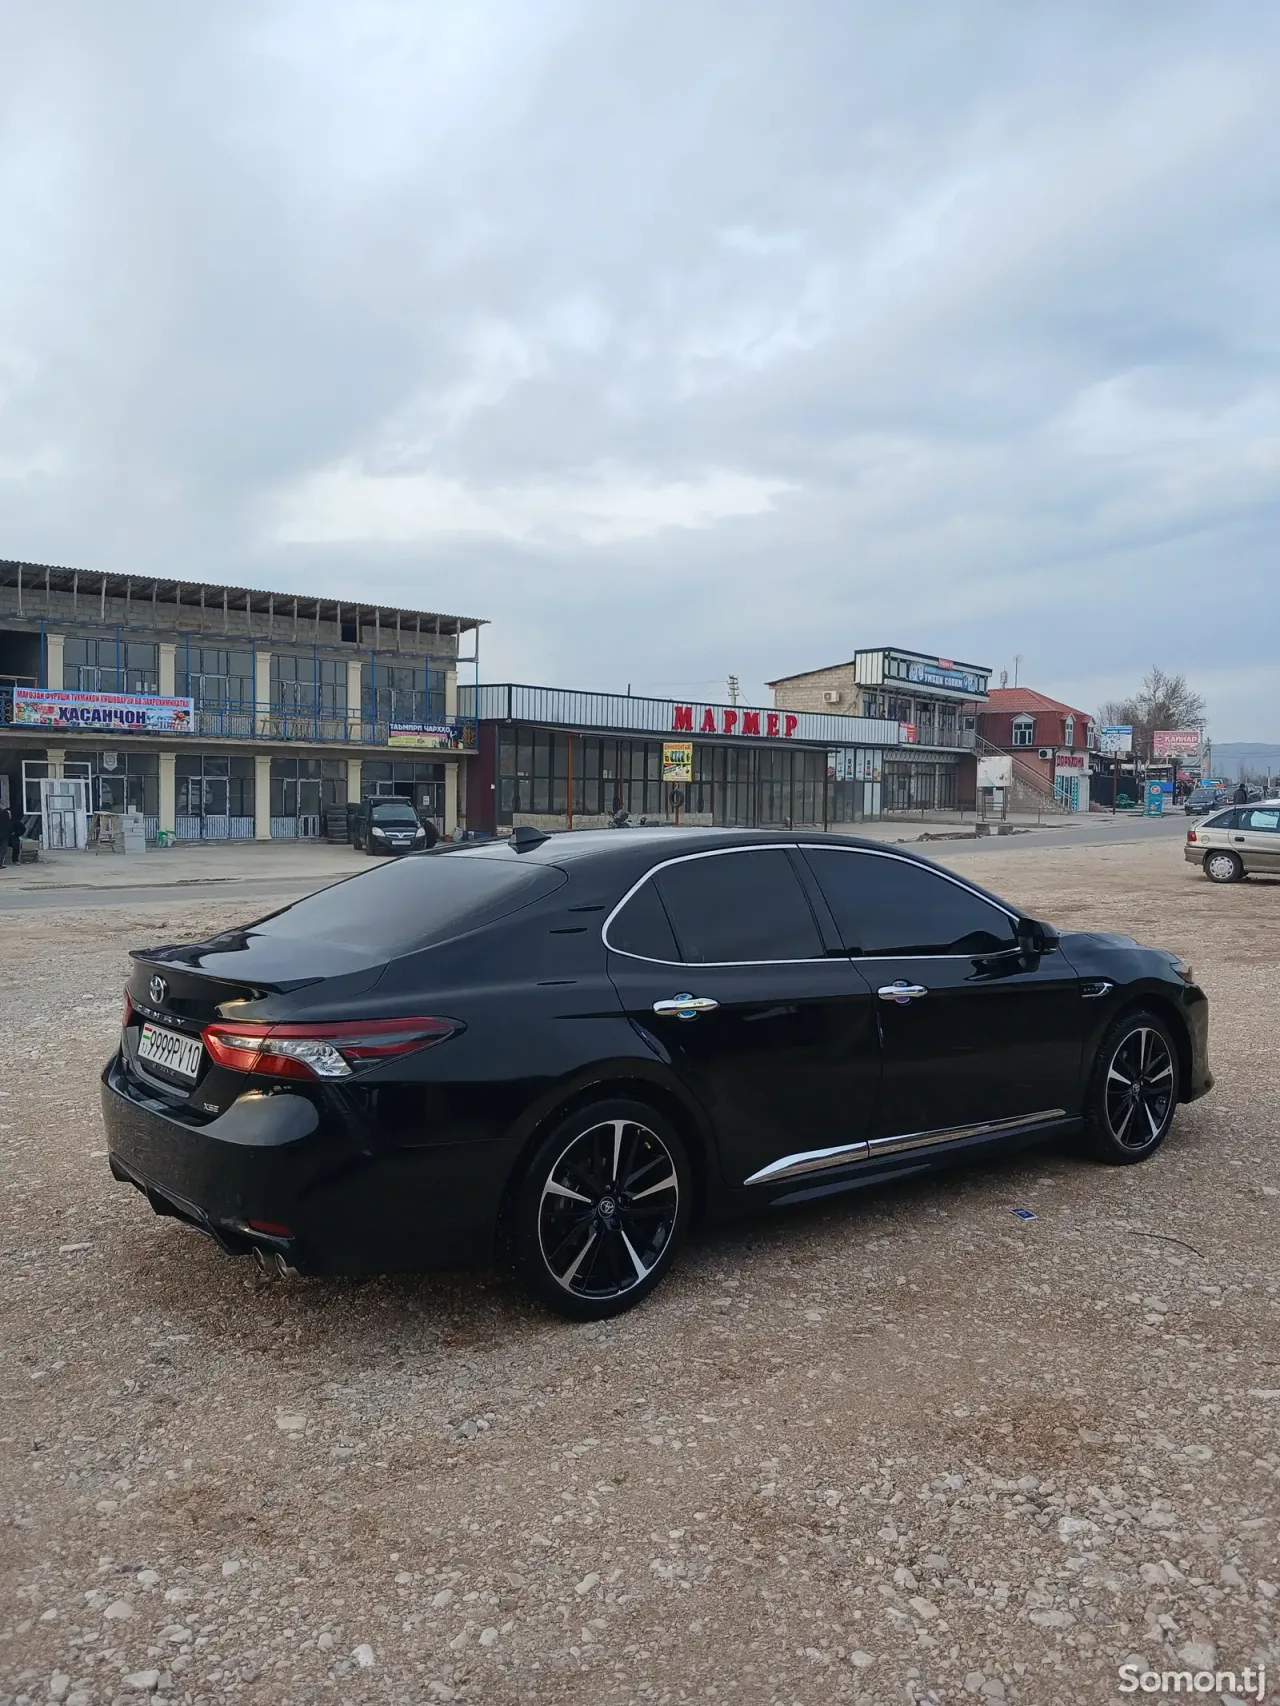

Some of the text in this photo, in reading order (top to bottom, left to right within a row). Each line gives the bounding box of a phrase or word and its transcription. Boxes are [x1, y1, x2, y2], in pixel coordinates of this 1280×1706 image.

[672, 706, 798, 737] МАРМЕР
[137, 1004, 186, 1026] CAMRY
[203, 1102, 220, 1113] XSE
